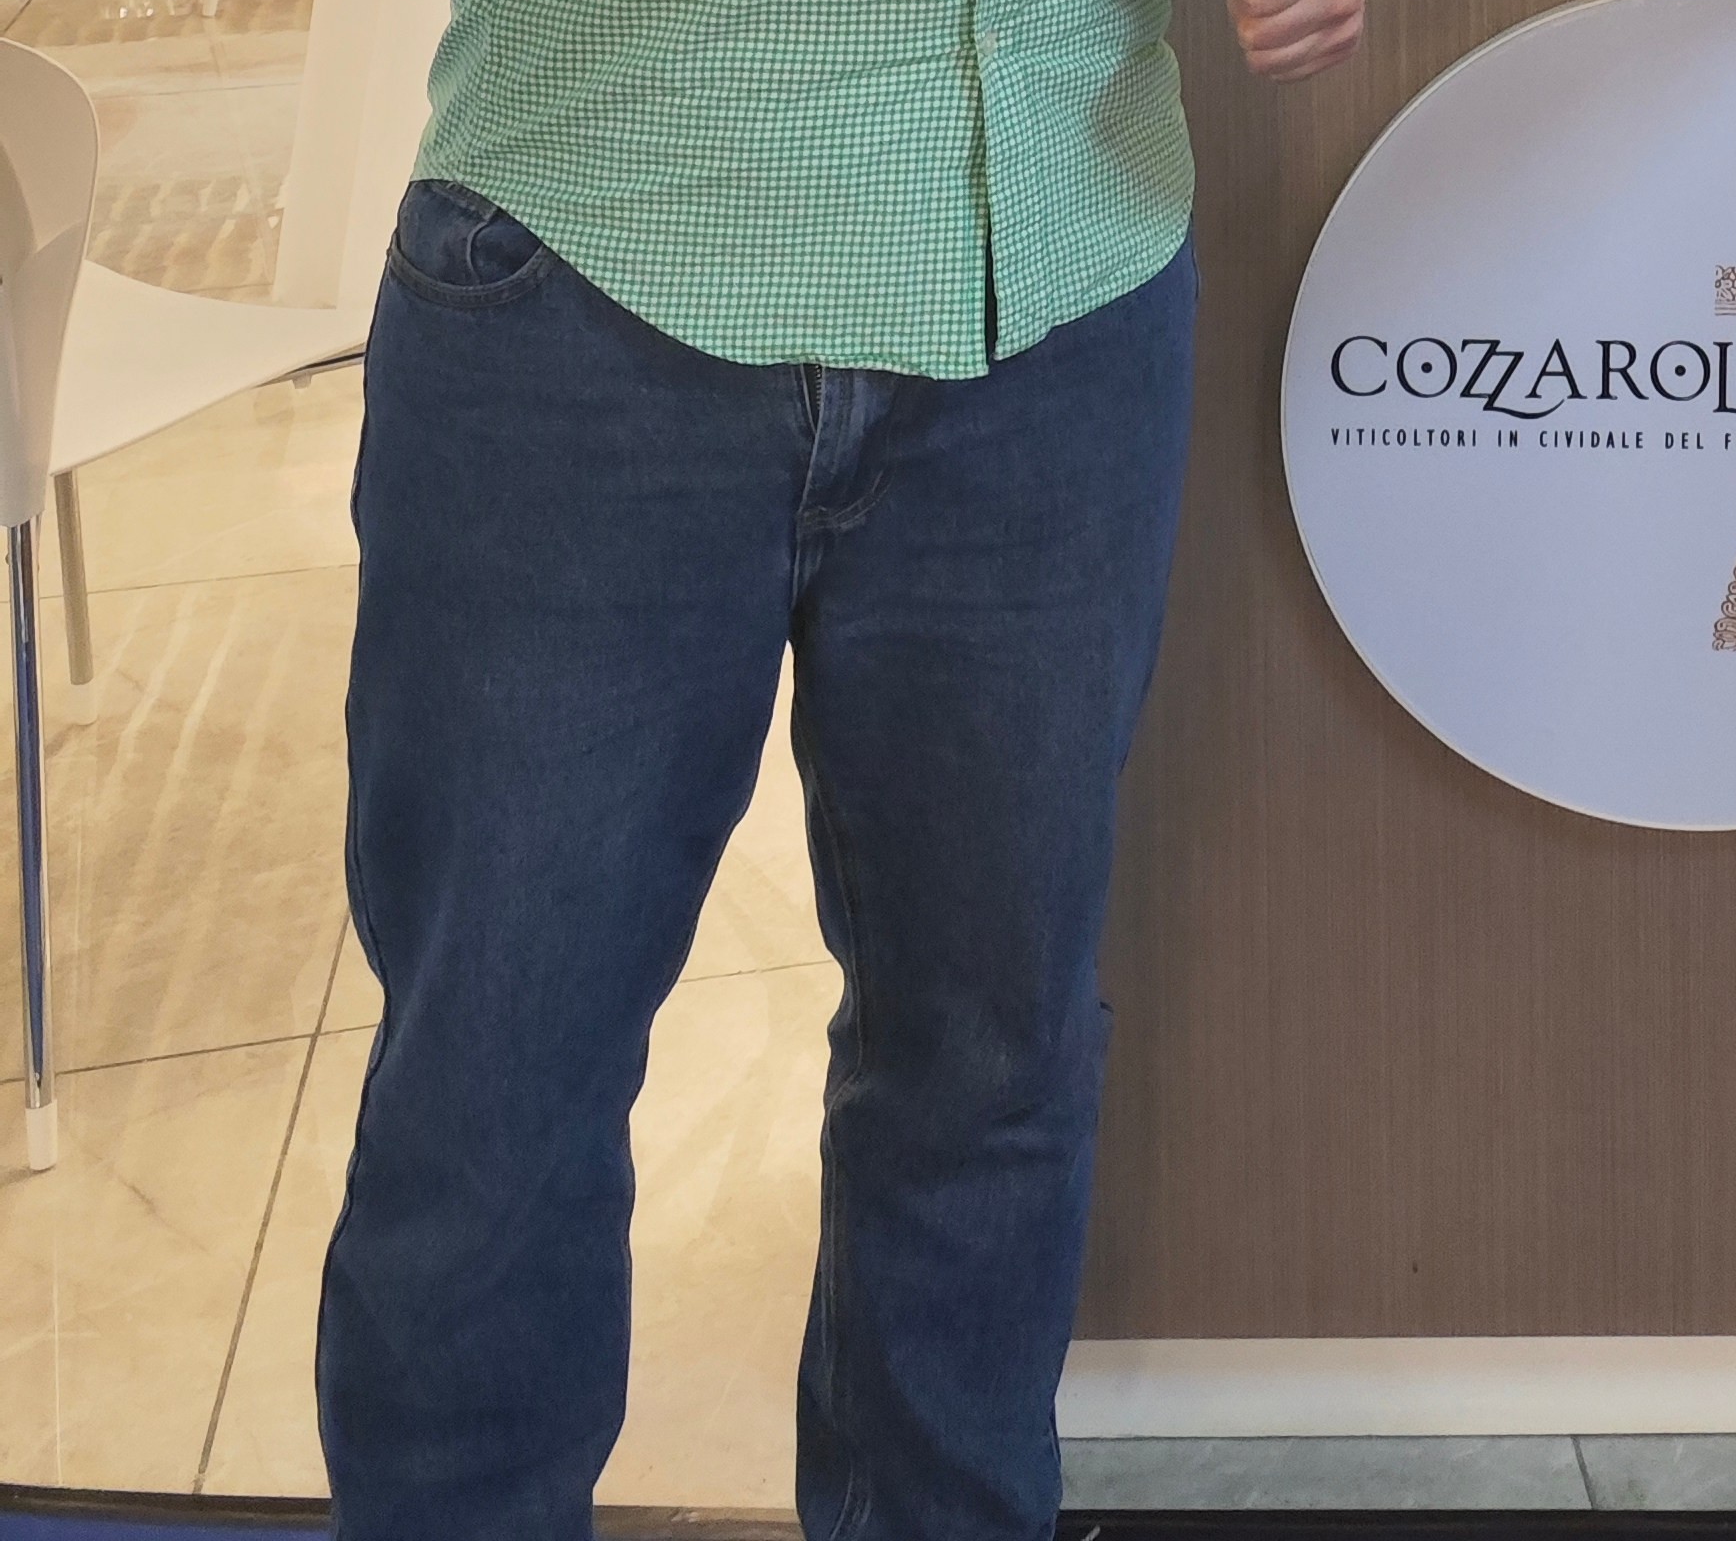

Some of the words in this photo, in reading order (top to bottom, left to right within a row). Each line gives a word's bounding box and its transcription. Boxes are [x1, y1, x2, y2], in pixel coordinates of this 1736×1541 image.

[1331, 428, 1477, 447] VITICOLTORI
[1497, 429, 1519, 448] IN
[1539, 429, 1645, 450] CIVIDALE
[1664, 431, 1705, 451] DEL
